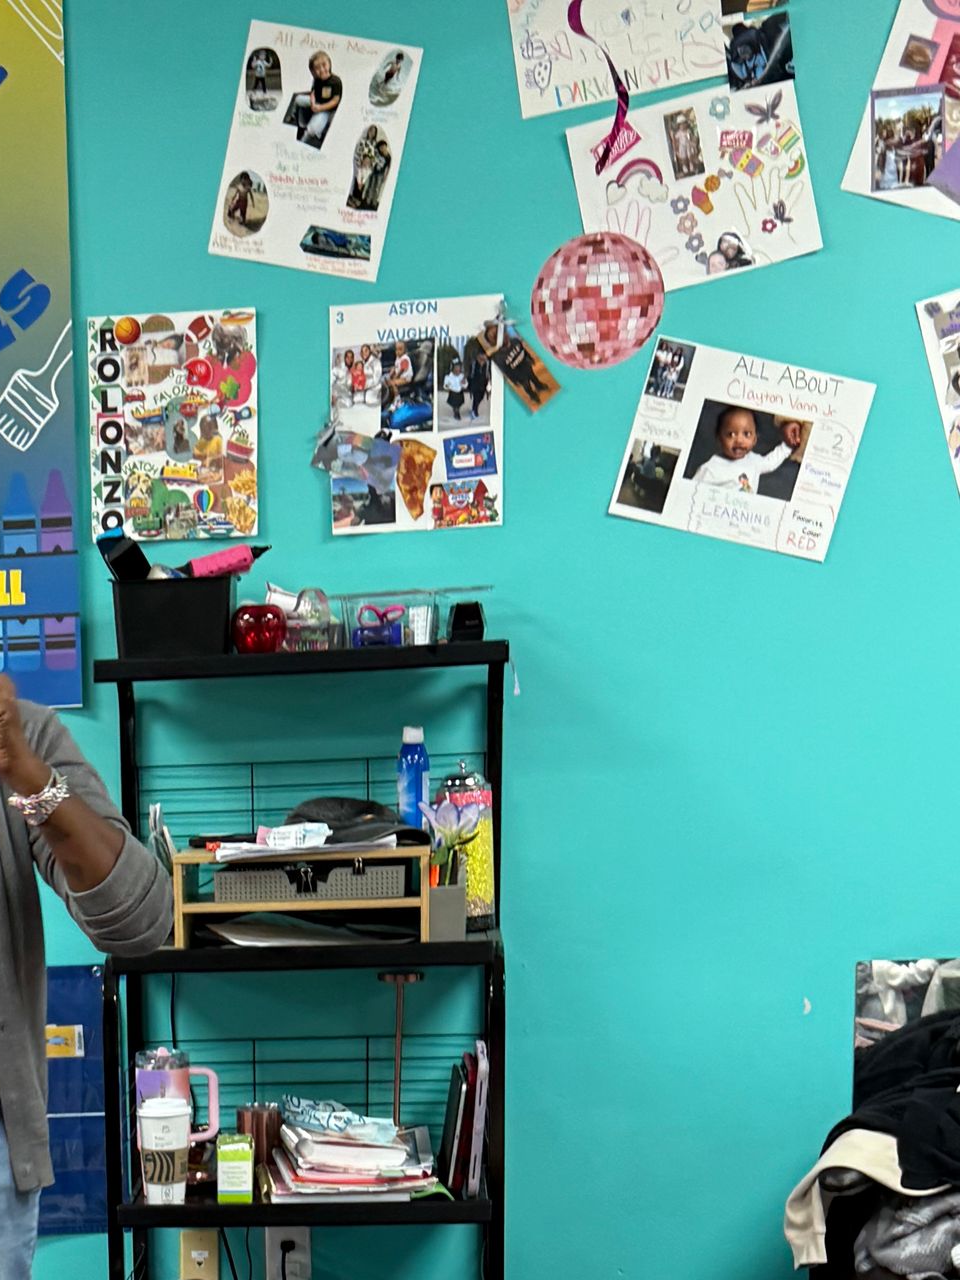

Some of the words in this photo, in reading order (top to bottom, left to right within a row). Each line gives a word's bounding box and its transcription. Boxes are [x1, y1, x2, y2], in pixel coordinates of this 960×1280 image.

[335, 311, 345, 324] 3
[389, 301, 439, 317] ASTON
[377, 325, 451, 342] VAUGHAN
[733, 355, 770, 382] ALL
[777, 365, 845, 397] ABOUT
[727, 377, 784, 407] Clayton
[789, 396, 819, 415] Vann
[832, 433, 845, 452] 2
[701, 503, 771, 527] LEARNING
[786, 532, 816, 551] RED
